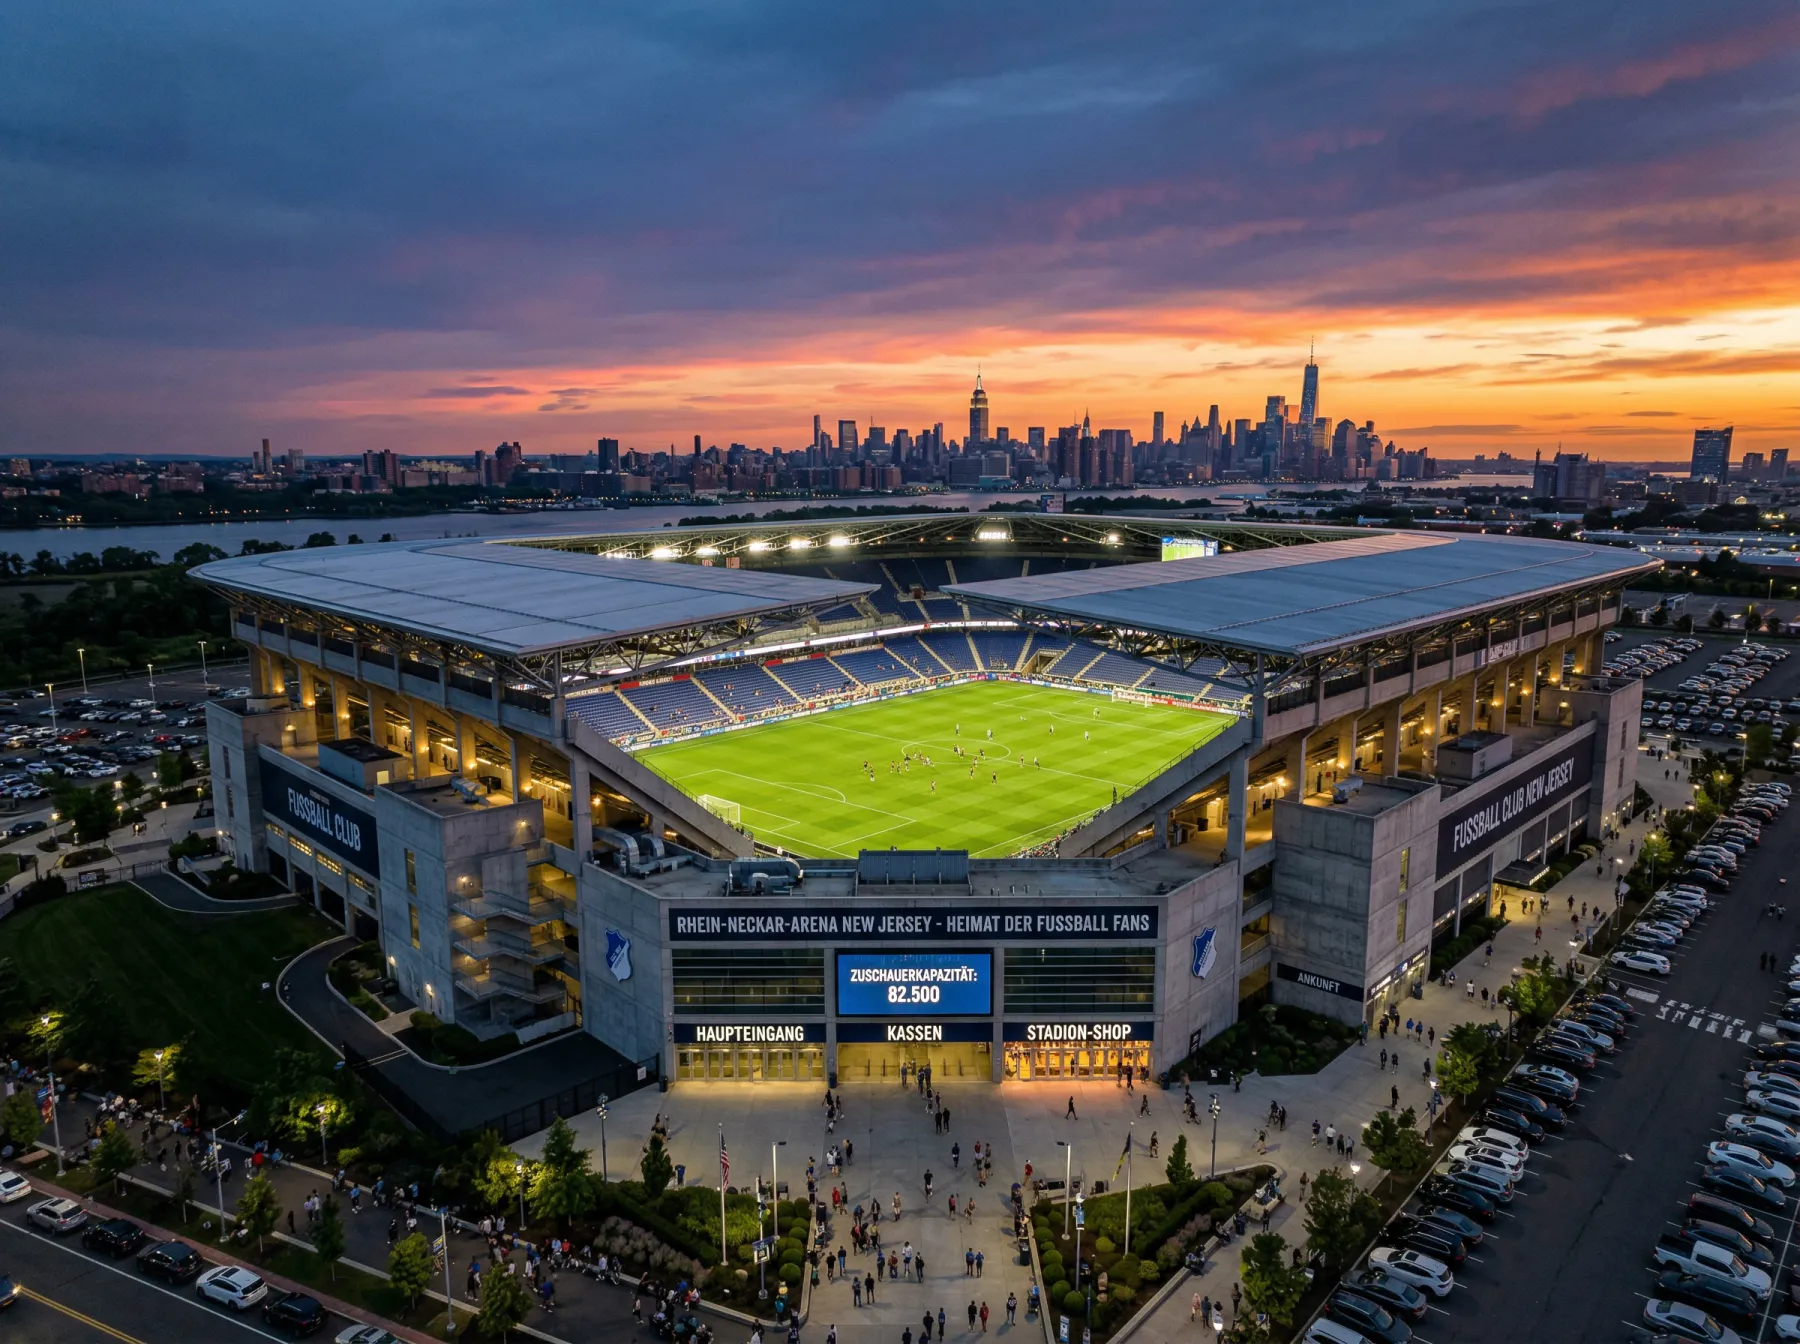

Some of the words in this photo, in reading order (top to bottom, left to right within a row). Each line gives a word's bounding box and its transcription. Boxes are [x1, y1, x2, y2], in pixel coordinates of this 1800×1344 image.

[1453, 802, 1500, 853] FUSSBALL
[1502, 787, 1524, 823] CLUB
[1526, 774, 1545, 808] NEW
[1544, 757, 1575, 796] JERSEY
[287, 787, 334, 836] FUSSBALL
[334, 813, 361, 852] CLUB
[677, 915, 838, 933] RHEIN-NECKAR-ARENA
[842, 915, 875, 933] NEW
[878, 915, 932, 933] JERSEY
[946, 915, 1002, 933] HEIMAT
[1005, 915, 1033, 932] DER
[1037, 914, 1109, 932] FUSSBALL
[1113, 914, 1150, 932] FANS
[850, 966, 978, 982] ZUSCHAUERKAPAZITÄT:
[1297, 972, 1341, 994] ANKUNFT
[887, 985, 940, 1003] 82.500
[696, 1025, 804, 1042] HAUPTEINGANG
[887, 1025, 942, 1042] KASSEN
[1027, 1023, 1132, 1041] STADION-SHOP
